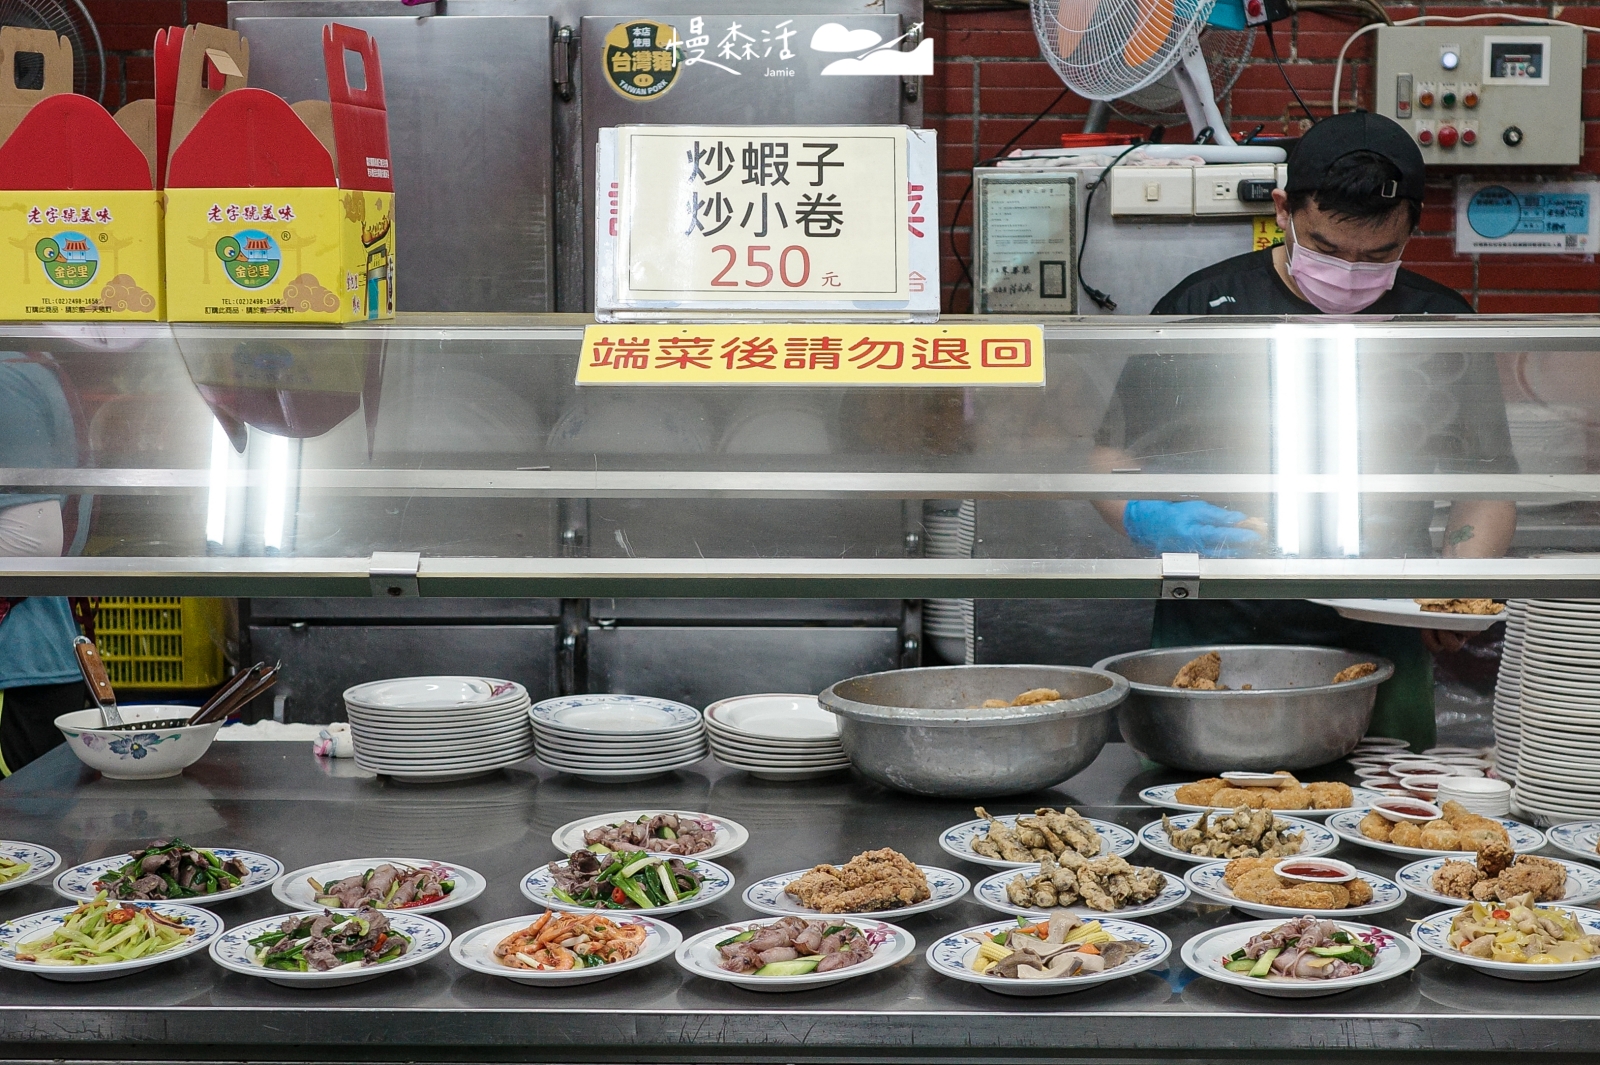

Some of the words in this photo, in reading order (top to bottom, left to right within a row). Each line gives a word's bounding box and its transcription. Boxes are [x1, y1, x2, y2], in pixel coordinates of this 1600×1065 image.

[632, 26, 651, 37] 本店
[632, 37, 651, 47] 使用
[611, 50, 673, 73] 台灣豬
[618, 80, 647, 96] TAIWAN
[647, 79, 668, 95] PORK
[686, 140, 845, 187] 炒蝦子
[27, 205, 114, 225] 老字號美味
[207, 203, 297, 224] 老字號美味
[684, 191, 845, 239] 炒小卷
[54, 265, 89, 279] 金包里
[234, 264, 271, 279] 金包里
[710, 244, 811, 288] 250
[820, 271, 842, 288] 元
[589, 336, 1032, 370] 端菜後請勿退回
